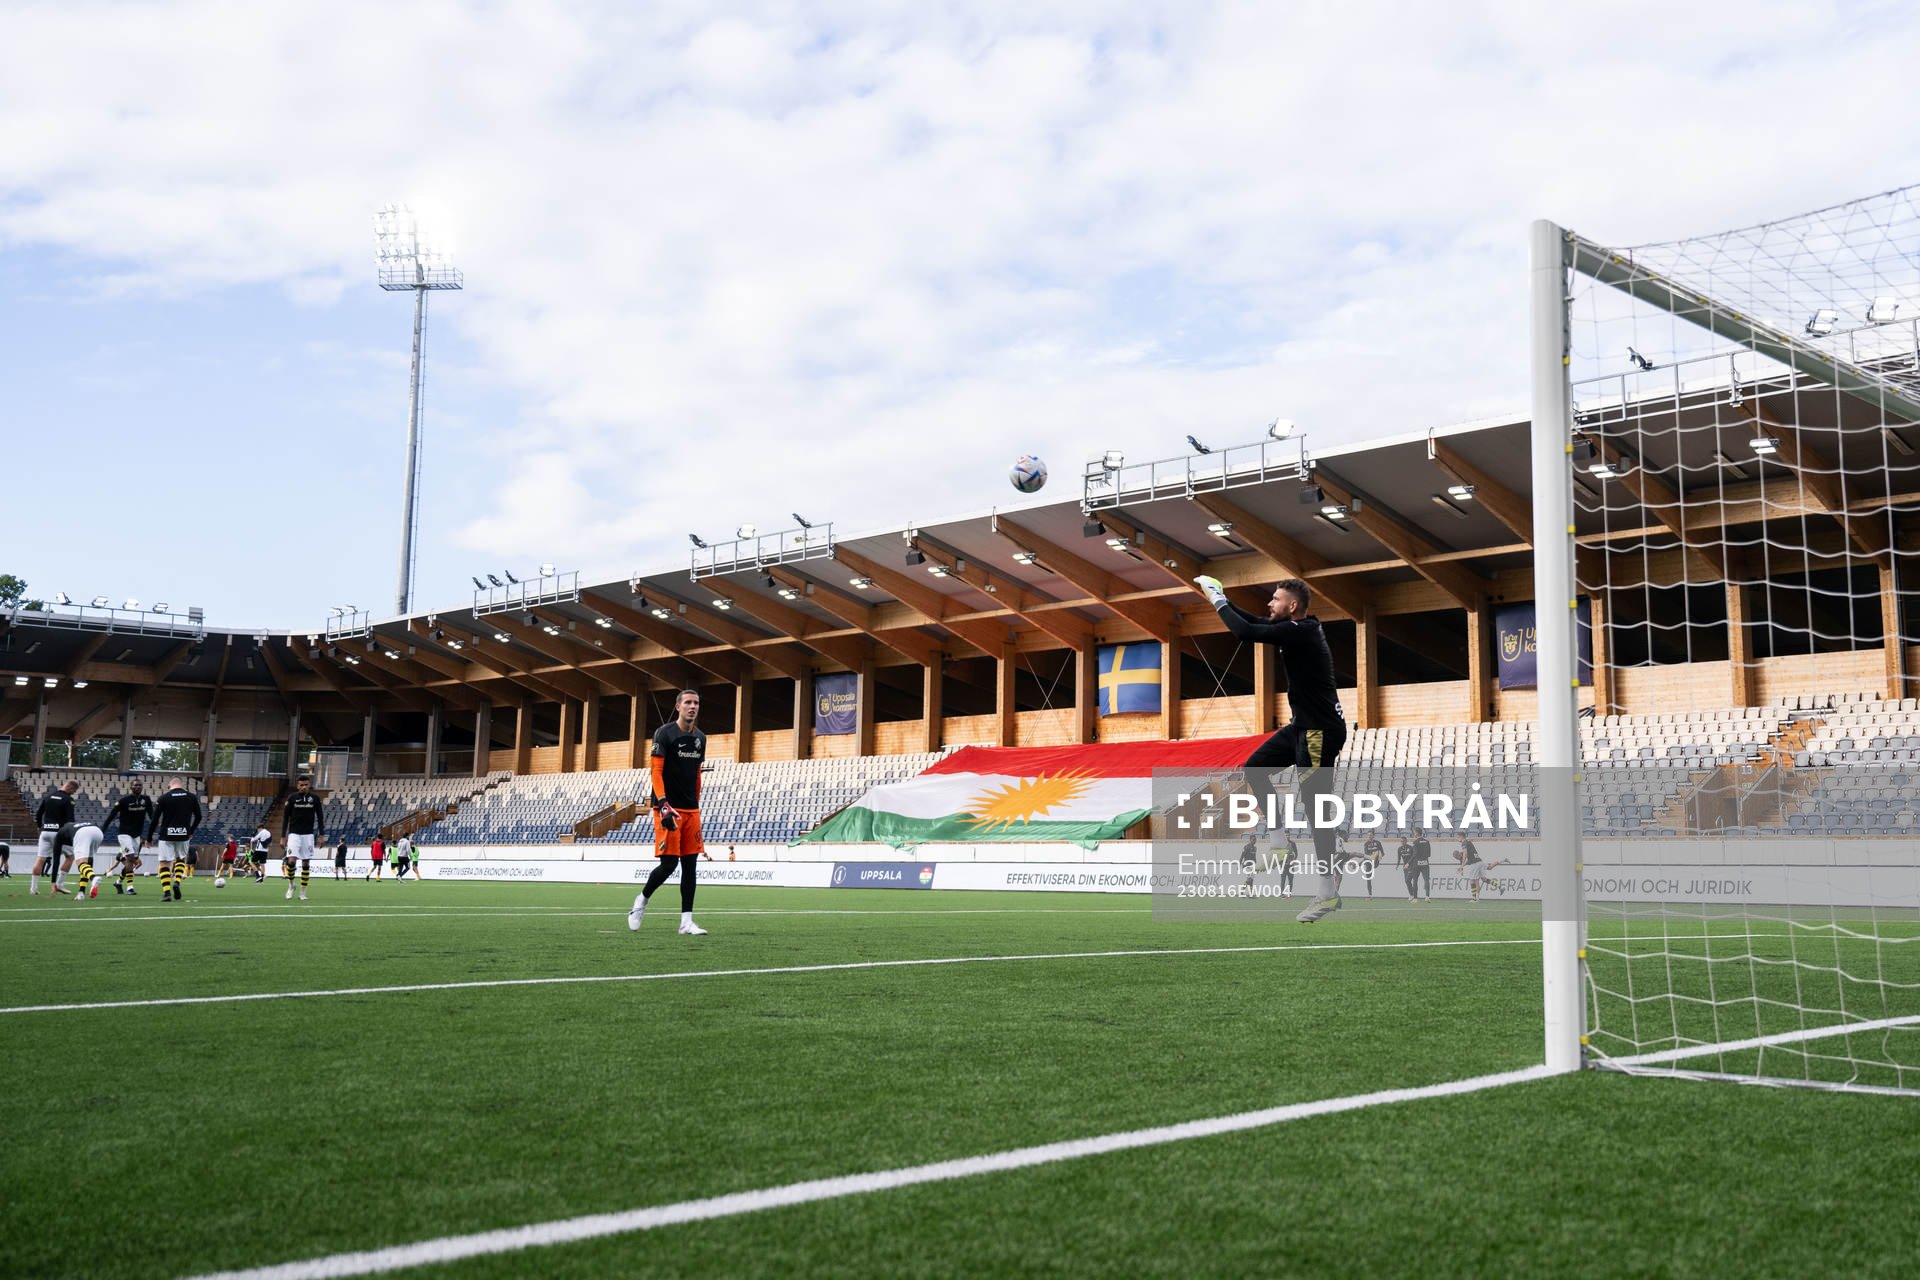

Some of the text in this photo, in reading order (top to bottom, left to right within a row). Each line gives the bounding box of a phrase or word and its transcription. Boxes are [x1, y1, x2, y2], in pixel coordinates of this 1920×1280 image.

[727, 870, 744, 880] OCH
[745, 870, 774, 881] JURIDIK
[860, 870, 902, 880] UPPSALA
[1006, 873, 1221, 888] EFFEKTIVISERA DIN EKONOMI OCH JURIDIK
[1641, 879, 1679, 894] OCH
[1685, 880, 1752, 895] JURIDIK
